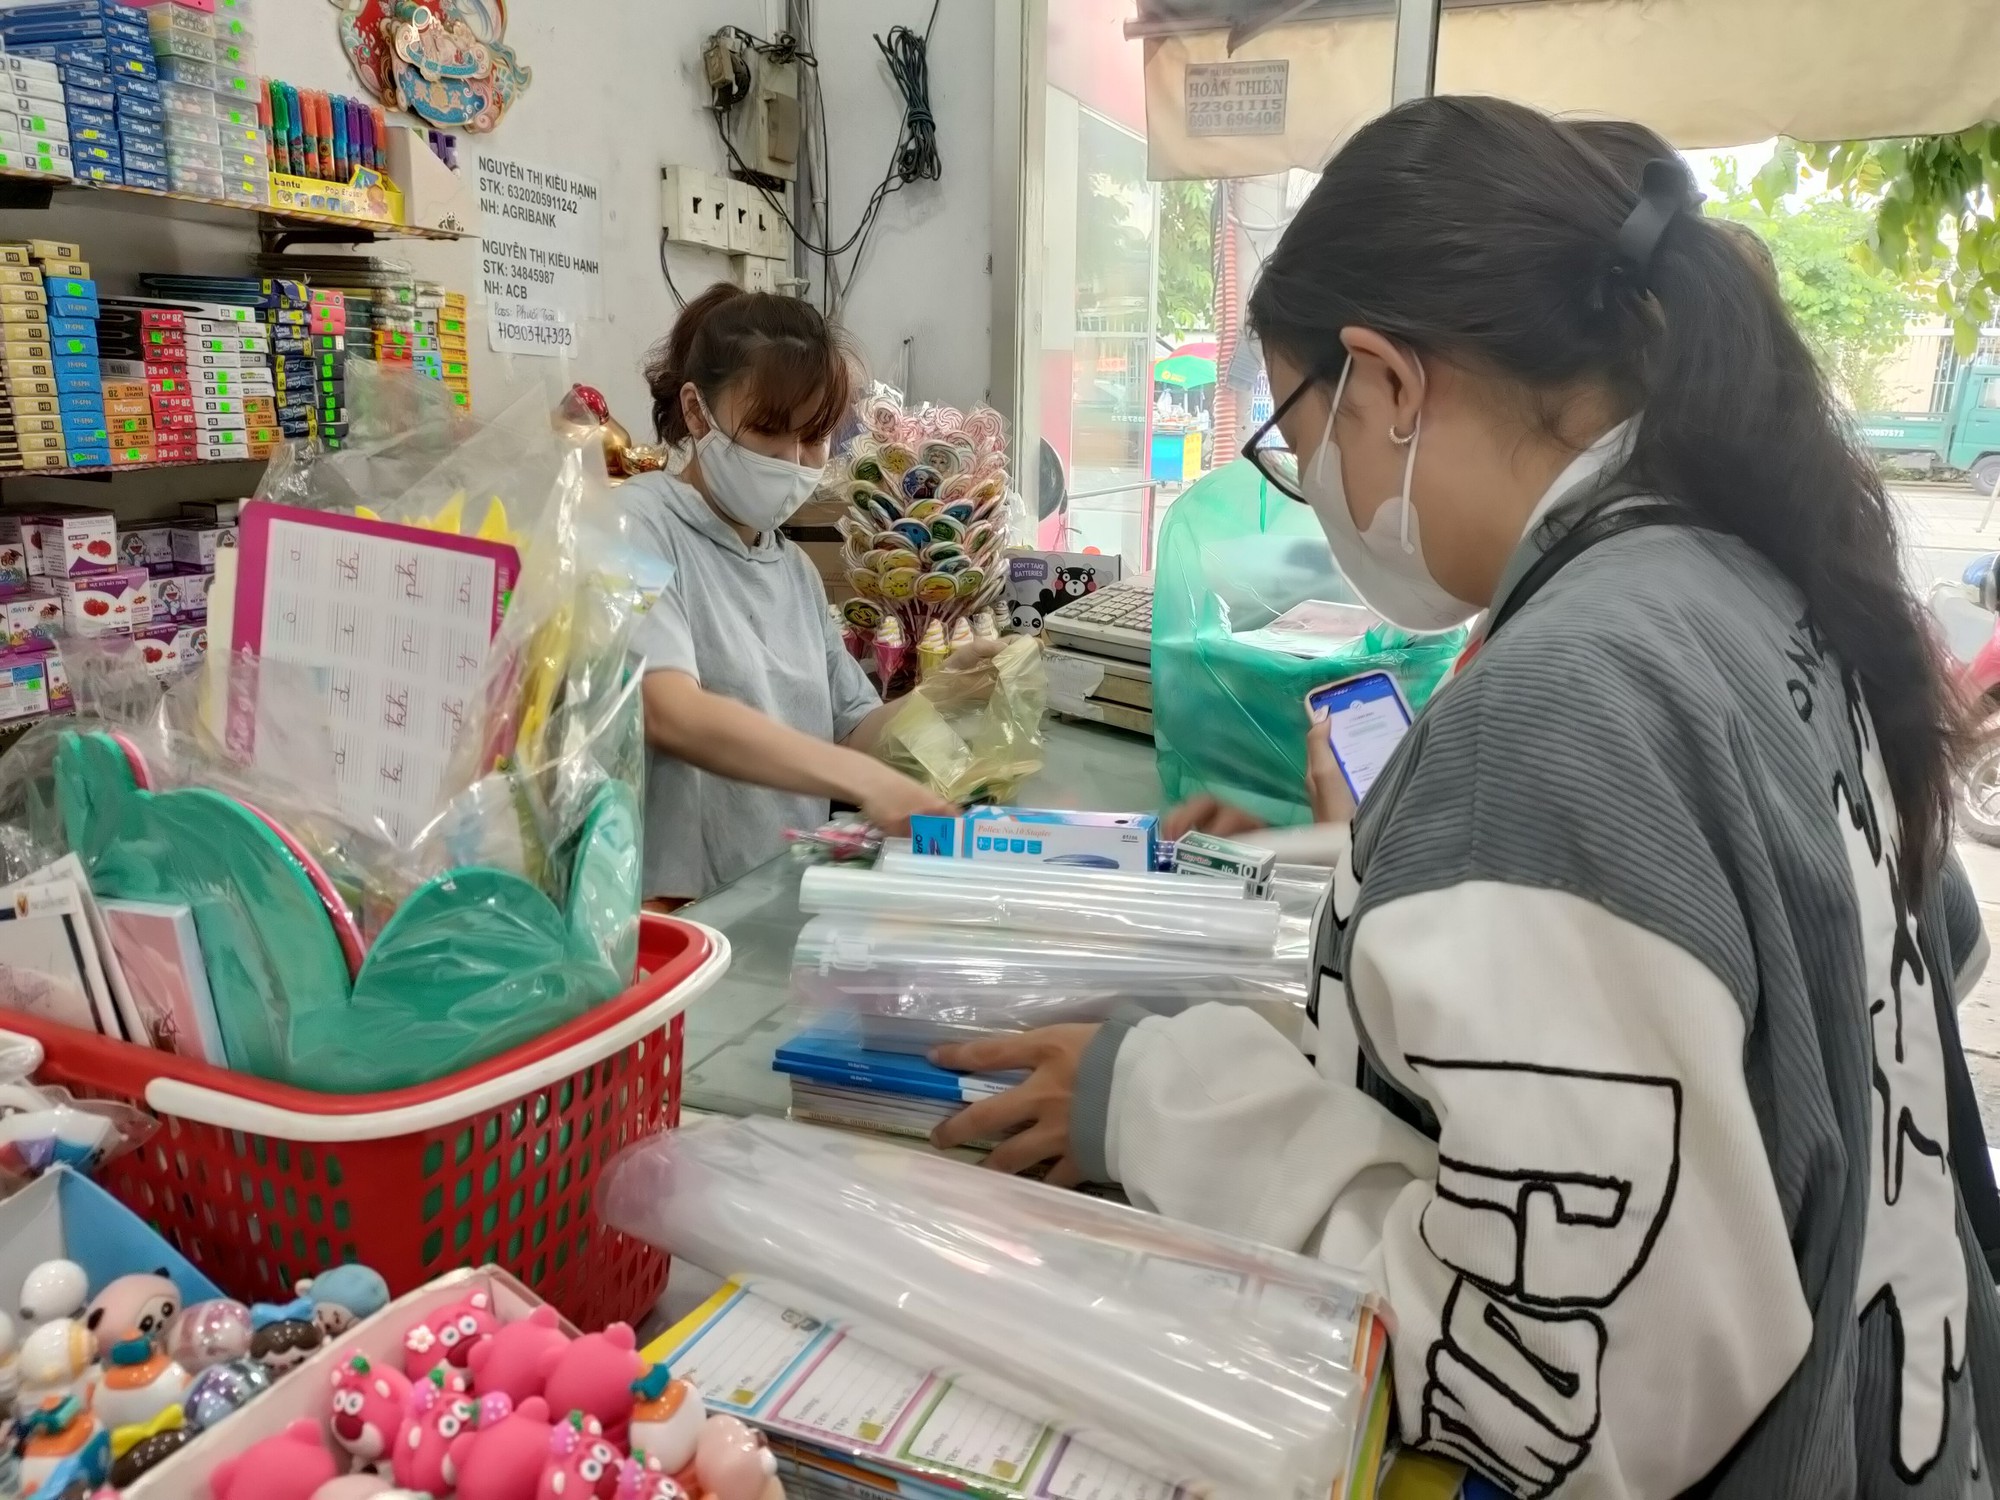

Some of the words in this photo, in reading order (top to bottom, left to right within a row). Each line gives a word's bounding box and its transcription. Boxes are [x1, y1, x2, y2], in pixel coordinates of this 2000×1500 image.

[1189, 99, 1283, 113] 22361115
[478, 156, 524, 181] NGUYỄN
[527, 168, 543, 190] THỊ
[545, 174, 568, 193] KIỀU
[570, 182, 597, 201] HẠNH
[274, 178, 301, 189] Lantu
[480, 177, 504, 196] STK:
[508, 184, 578, 214] 6320205911242
[480, 198, 500, 215] NH:
[502, 204, 557, 228] AGRIBANK
[59, 248, 70, 256] HB
[7, 253, 18, 261] HB
[482, 239, 527, 259] NGUYỄN
[529, 248, 546, 268] THỊ
[549, 252, 571, 270] KIỀU
[573, 259, 599, 275] HẠNH
[70, 266, 80, 274] HB
[483, 260, 508, 277] STK:
[510, 265, 555, 285] 34845987
[21, 272, 32, 280] HB
[484, 280, 502, 296] NH:
[506, 286, 528, 299] ACB
[26, 292, 38, 300] HB
[172, 314, 182, 322] 2B
[30, 348, 42, 356] HB
[174, 348, 184, 357] 2B
[34, 366, 46, 374] HB
[148, 366, 158, 374] 2B
[37, 384, 48, 392] HB
[151, 384, 160, 392] 2B
[40, 402, 51, 410] HB
[182, 398, 190, 406] 2B
[114, 404, 142, 413] Mango
[138, 418, 148, 426] 2B
[121, 453, 148, 461] Mgo
[158, 450, 168, 458] 2B
[1012, 562, 1030, 570] DON'T
[1014, 570, 1043, 578] BATTERIES
[978, 824, 1001, 834] Pollex
[1024, 827, 1052, 838] Stapler
[1200, 842, 1220, 851] 10
[1221, 864, 1235, 876] No.
[1236, 863, 1254, 878] 10
